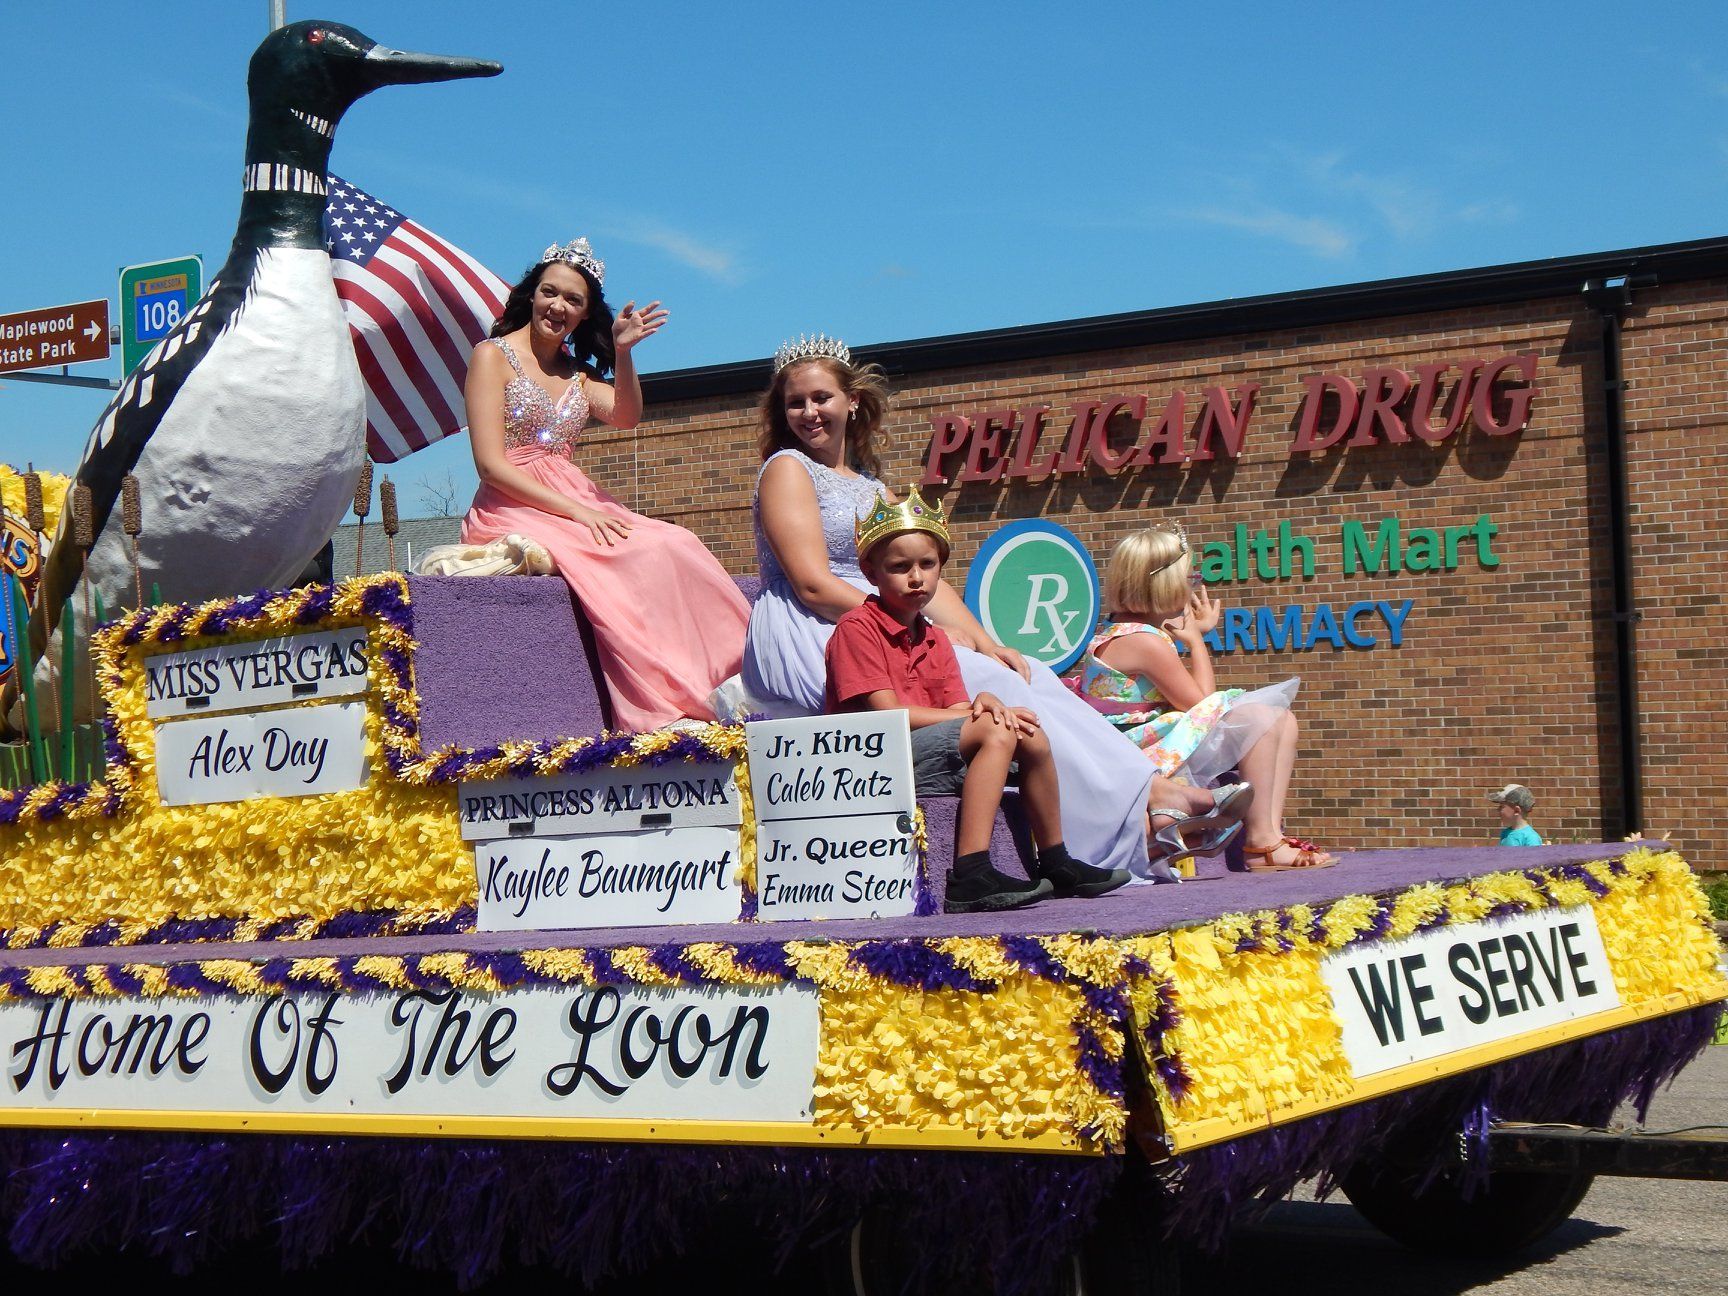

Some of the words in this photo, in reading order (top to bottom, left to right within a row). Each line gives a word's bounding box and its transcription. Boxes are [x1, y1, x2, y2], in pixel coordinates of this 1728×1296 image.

[143, 299, 180, 331] 108
[0, 346, 33, 365] tate
[41, 339, 76, 359] Park
[921, 381, 1262, 486] PELICAN
[1288, 352, 1541, 453] DRUG
[1192, 519, 1315, 583] alth
[1342, 513, 1500, 575] Mart
[148, 659, 221, 701] MISS
[226, 638, 368, 691] VERGAS
[188, 728, 254, 779] Alex
[262, 727, 329, 784] Day
[766, 735, 802, 759] Jr.
[811, 729, 886, 758] King
[465, 787, 594, 823] PRINCESS
[603, 778, 729, 812] ALTONA
[767, 767, 826, 806] Caleb
[832, 767, 893, 801] Ratz
[764, 838, 798, 863] Jr.
[805, 835, 909, 865] Queen
[484, 847, 570, 918] Kaylee
[580, 848, 732, 912] Baumgart
[763, 873, 834, 906] Emma
[841, 870, 915, 903] Steer
[1347, 953, 1445, 1047] WE
[1447, 922, 1598, 1025] SERVE
[13, 1000, 211, 1091] Home
[250, 992, 346, 1096] Of
[385, 987, 518, 1095] The
[544, 985, 771, 1097] Loon
